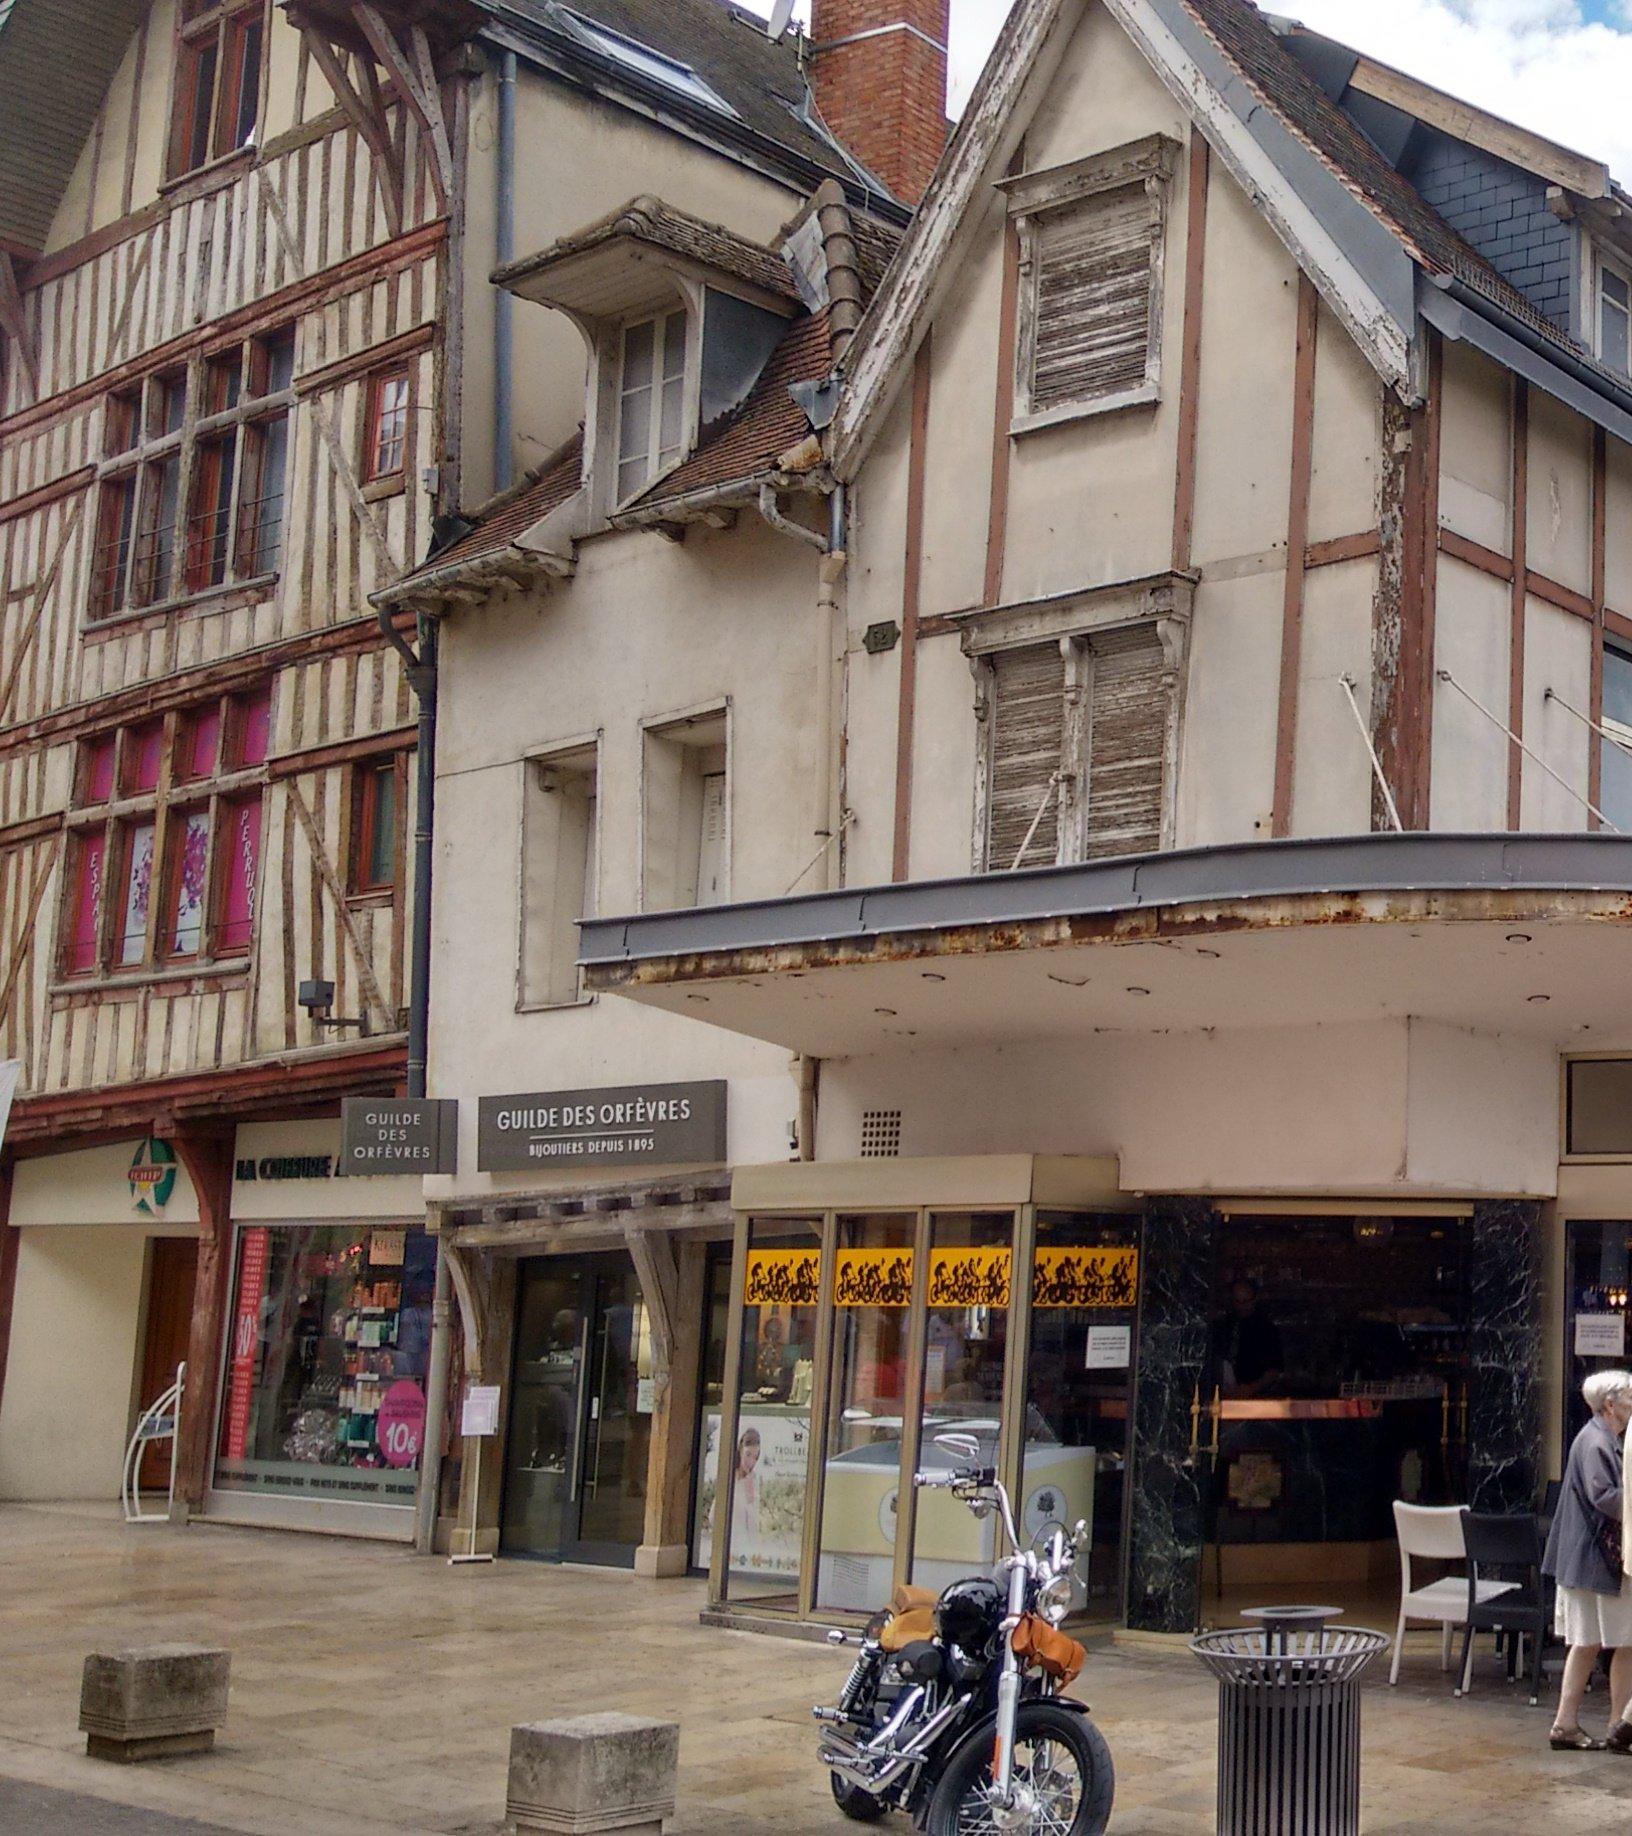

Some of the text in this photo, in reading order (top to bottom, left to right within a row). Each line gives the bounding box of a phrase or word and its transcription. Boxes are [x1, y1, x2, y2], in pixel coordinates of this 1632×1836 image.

[365, 1112, 421, 1126] GUILDE
[497, 1096, 691, 1130] GUILDE DES ORFÈVRES
[378, 1129, 407, 1142] DES
[354, 1143, 431, 1160] ORFÈVRES
[529, 1137, 655, 1158] BIJOUTIERS DEPUIS 1895
